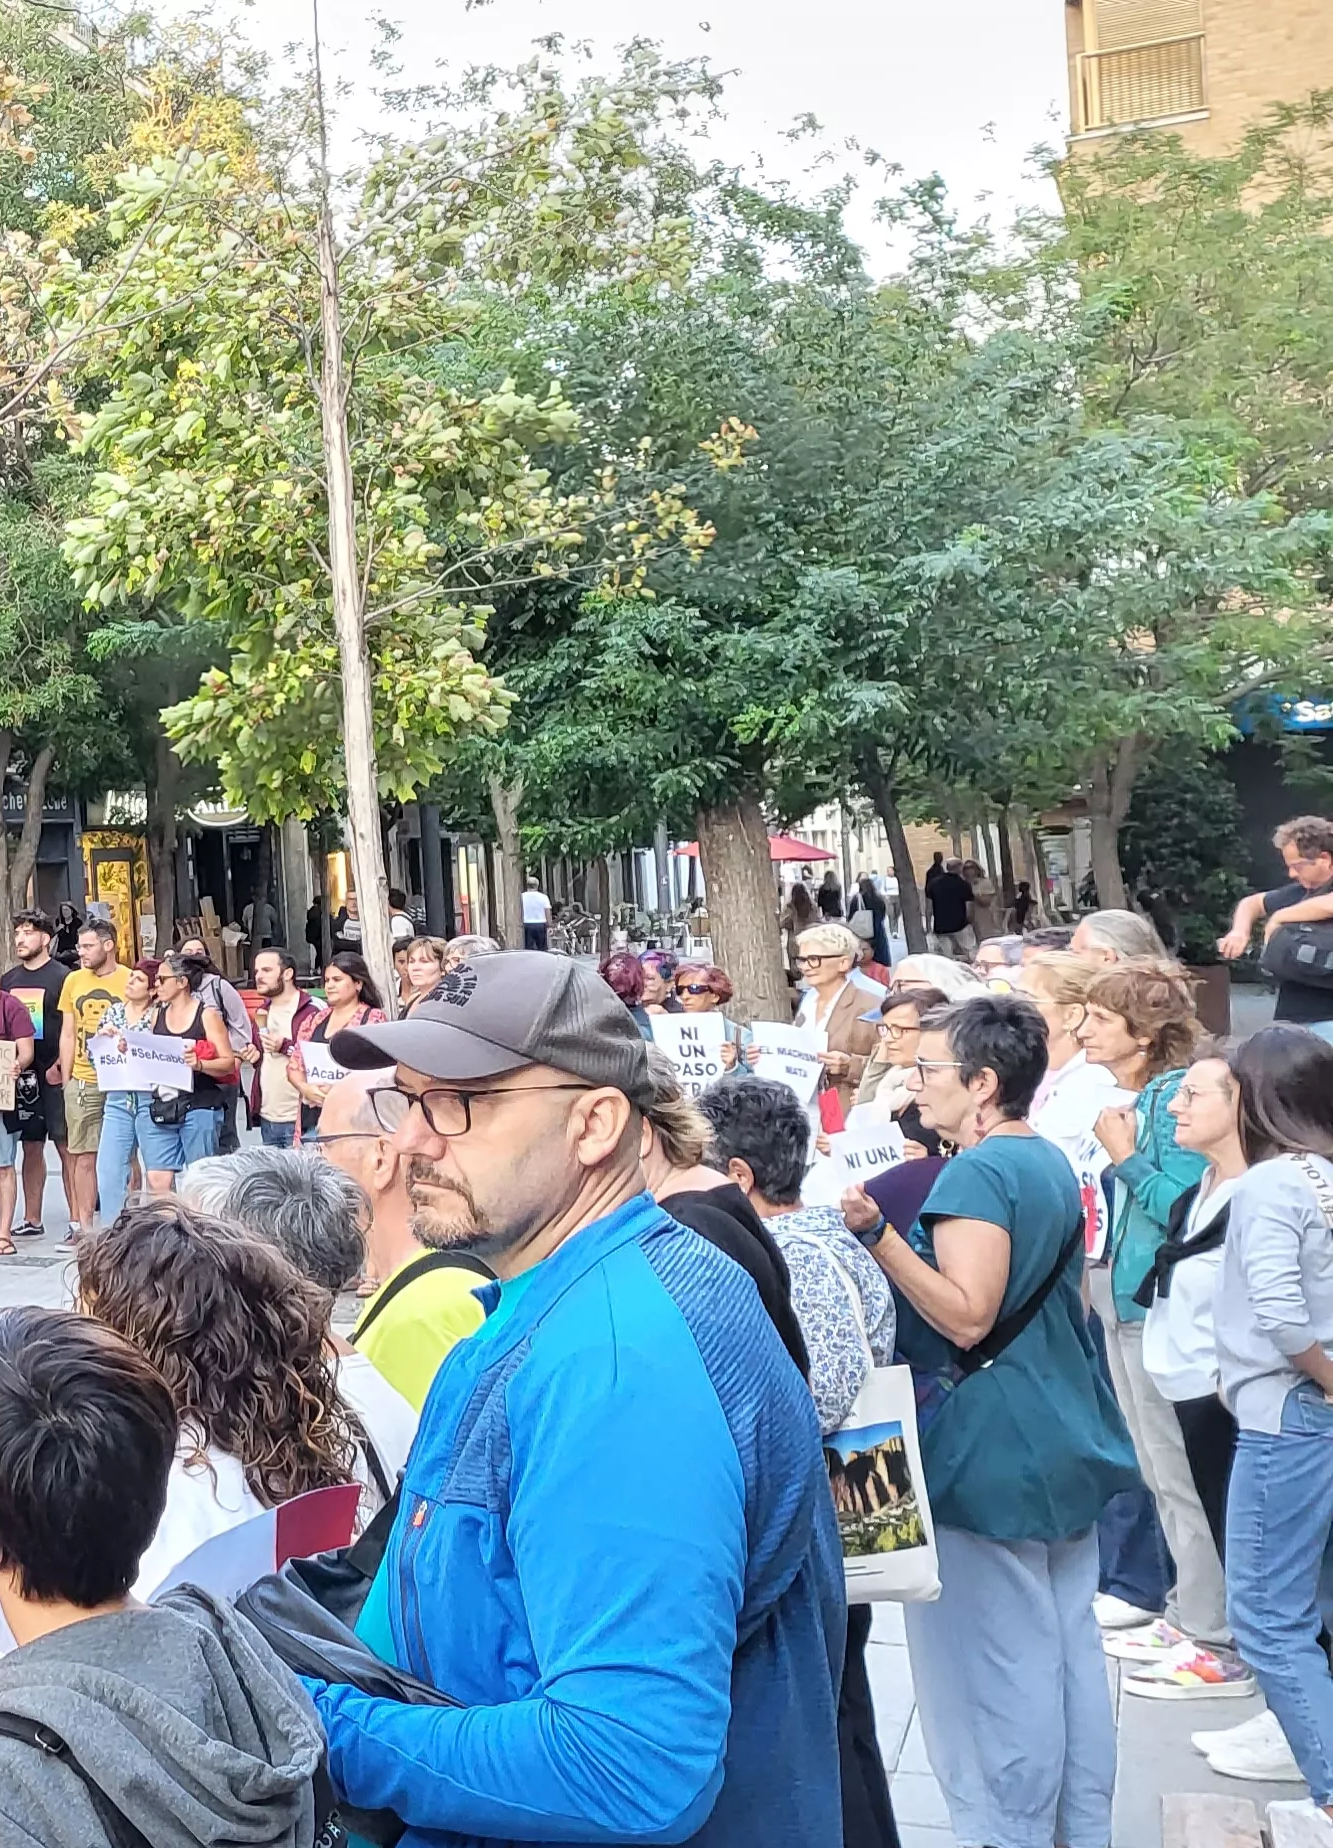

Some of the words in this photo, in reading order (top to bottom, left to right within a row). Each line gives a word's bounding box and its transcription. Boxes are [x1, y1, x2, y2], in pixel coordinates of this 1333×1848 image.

[680, 1026, 698, 1041] NI
[679, 1044, 706, 1058] UN
[759, 1045, 773, 1055] EL
[100, 1053, 127, 1067] #SeA
[673, 1064, 718, 1077] PASO
[785, 1065, 808, 1079] MATA
[844, 1153, 861, 1170] NI
[868, 1145, 901, 1165] UNA
